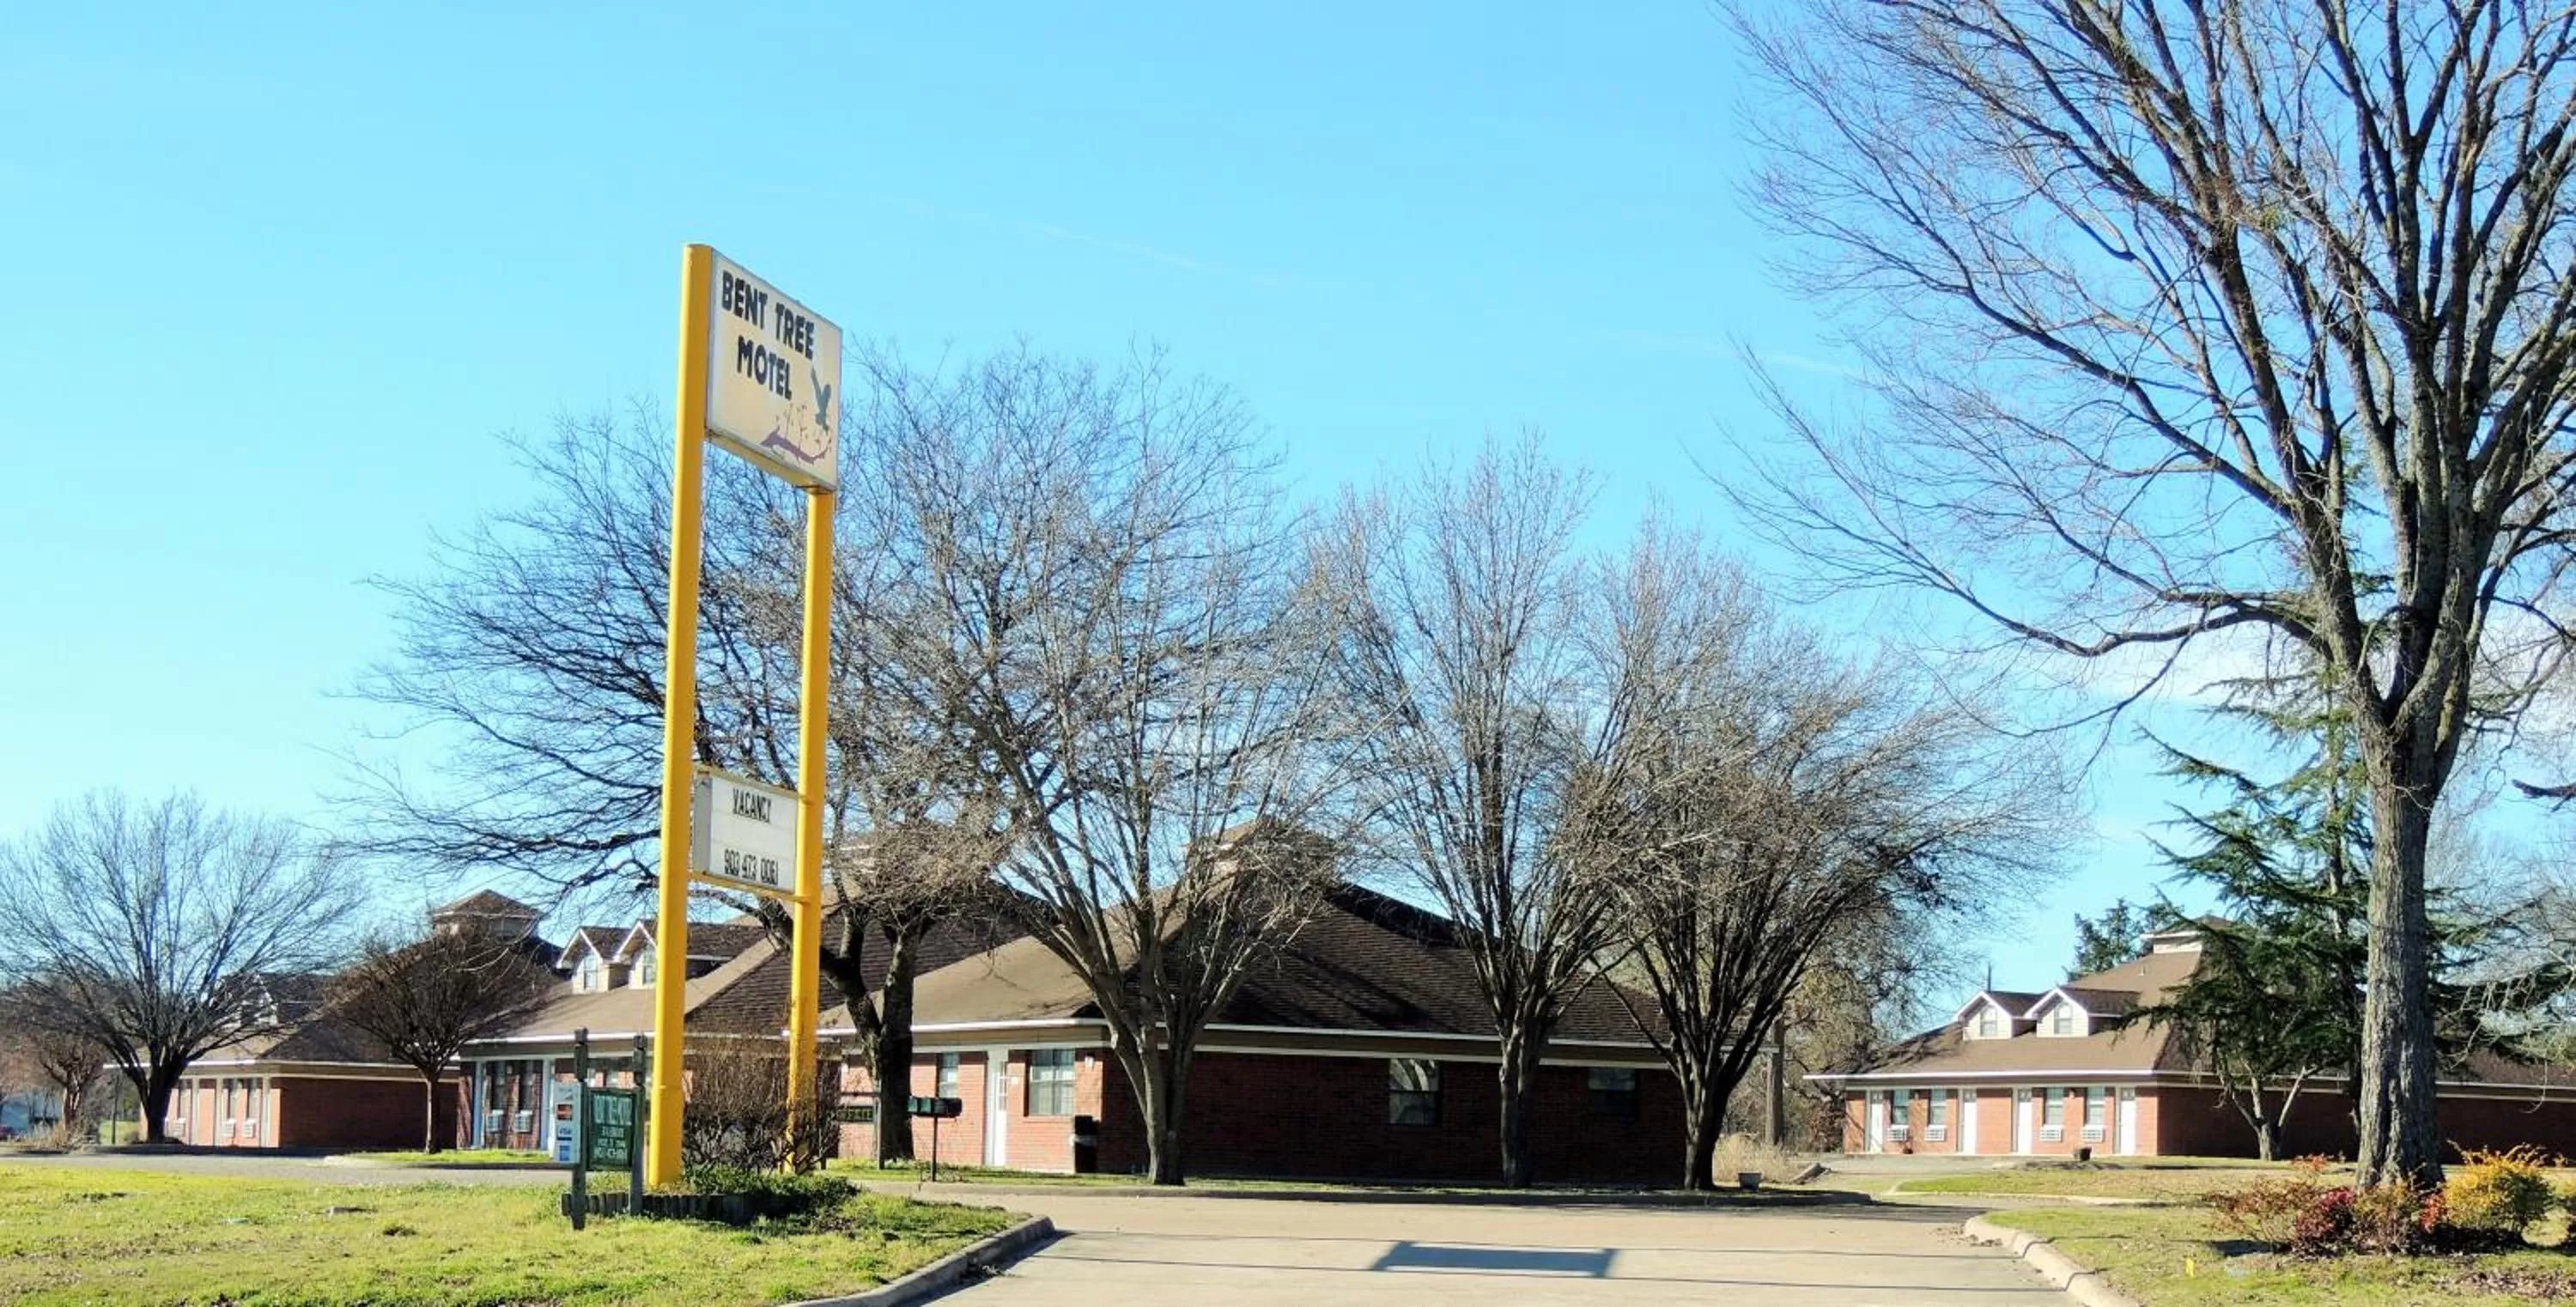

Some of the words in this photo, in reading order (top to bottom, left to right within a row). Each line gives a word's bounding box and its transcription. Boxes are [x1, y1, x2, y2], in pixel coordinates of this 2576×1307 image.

[722, 271, 768, 330] BENT
[775, 301, 815, 361] TREE
[737, 334, 792, 401] MOTEL
[732, 787, 772, 823] VACANCY
